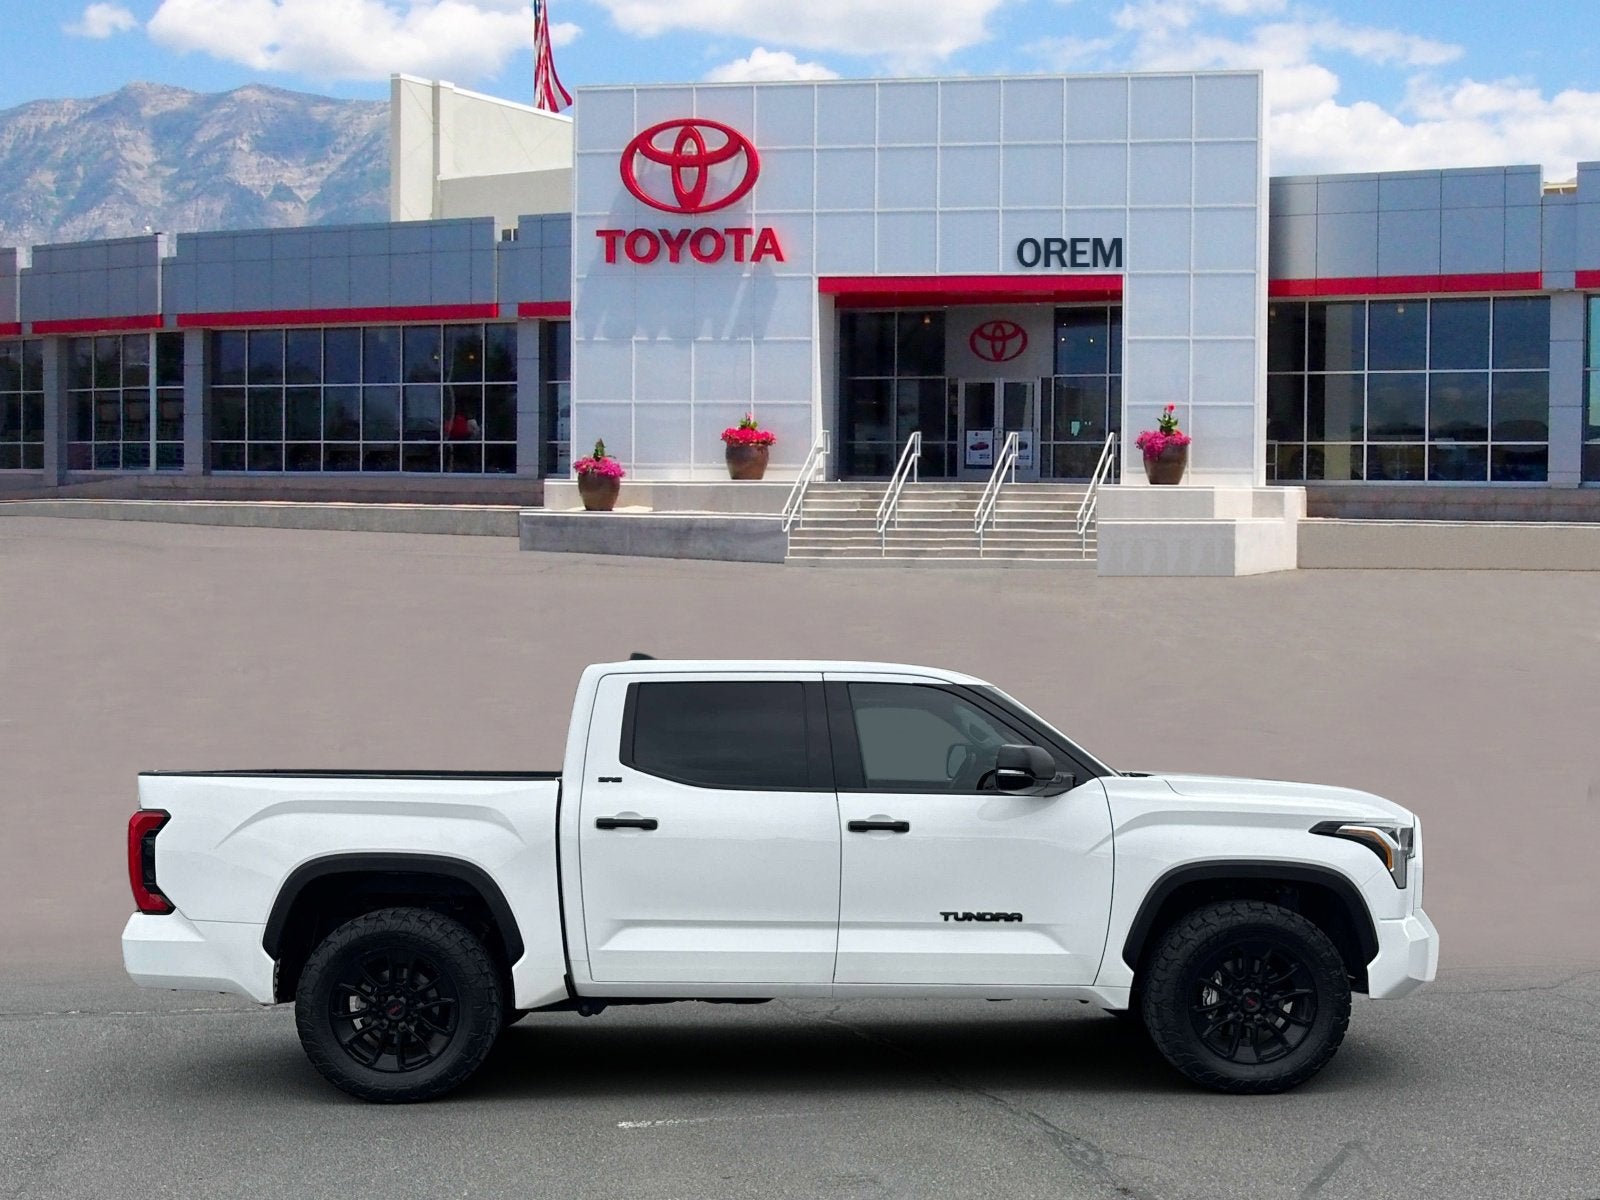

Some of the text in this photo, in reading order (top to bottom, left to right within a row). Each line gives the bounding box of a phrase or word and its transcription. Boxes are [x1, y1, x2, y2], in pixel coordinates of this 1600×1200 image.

[596, 227, 785, 264] TOYOTA
[1017, 237, 1123, 268] OREM
[939, 911, 1023, 922] TUNDRA
